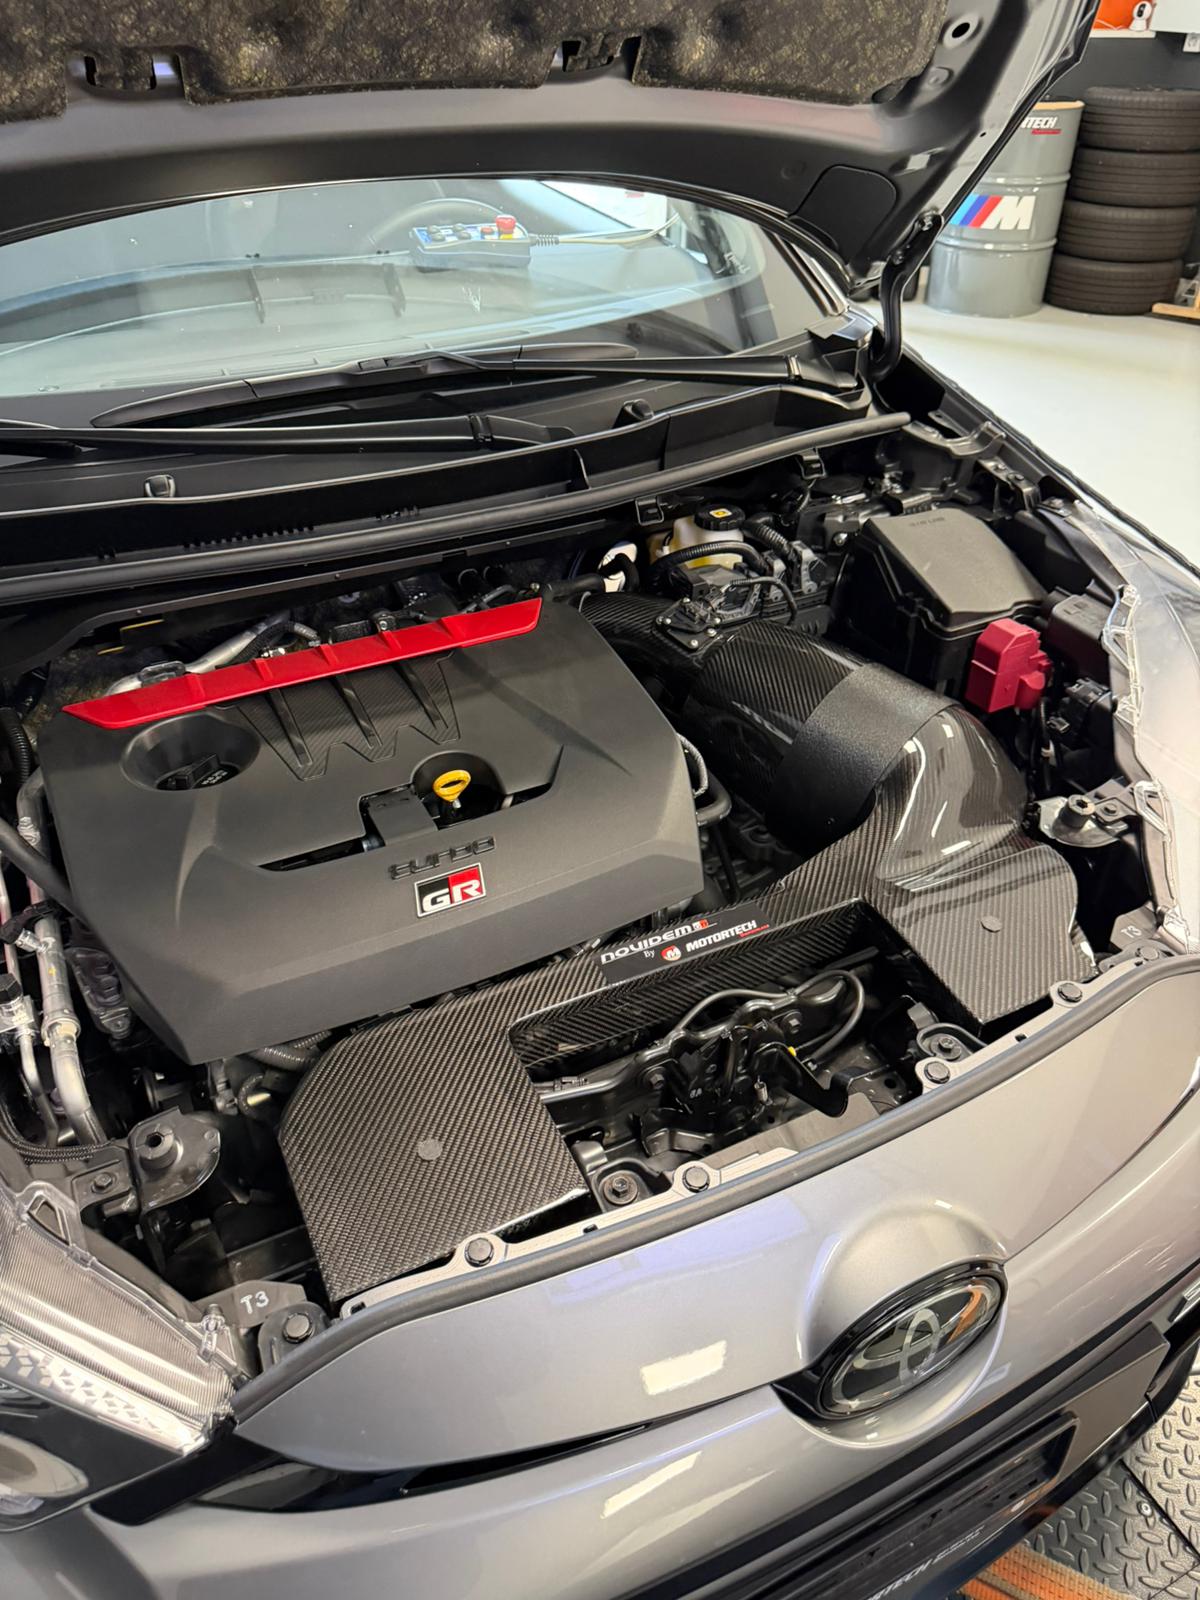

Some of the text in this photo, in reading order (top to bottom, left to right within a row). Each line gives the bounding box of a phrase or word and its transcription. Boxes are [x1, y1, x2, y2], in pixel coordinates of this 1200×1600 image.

[981, 195, 1036, 230] M
[421, 879, 482, 913] GR
[643, 949, 655, 958] By
[686, 920, 756, 951] MOTORTECH
[240, 1290, 269, 1315] T3
